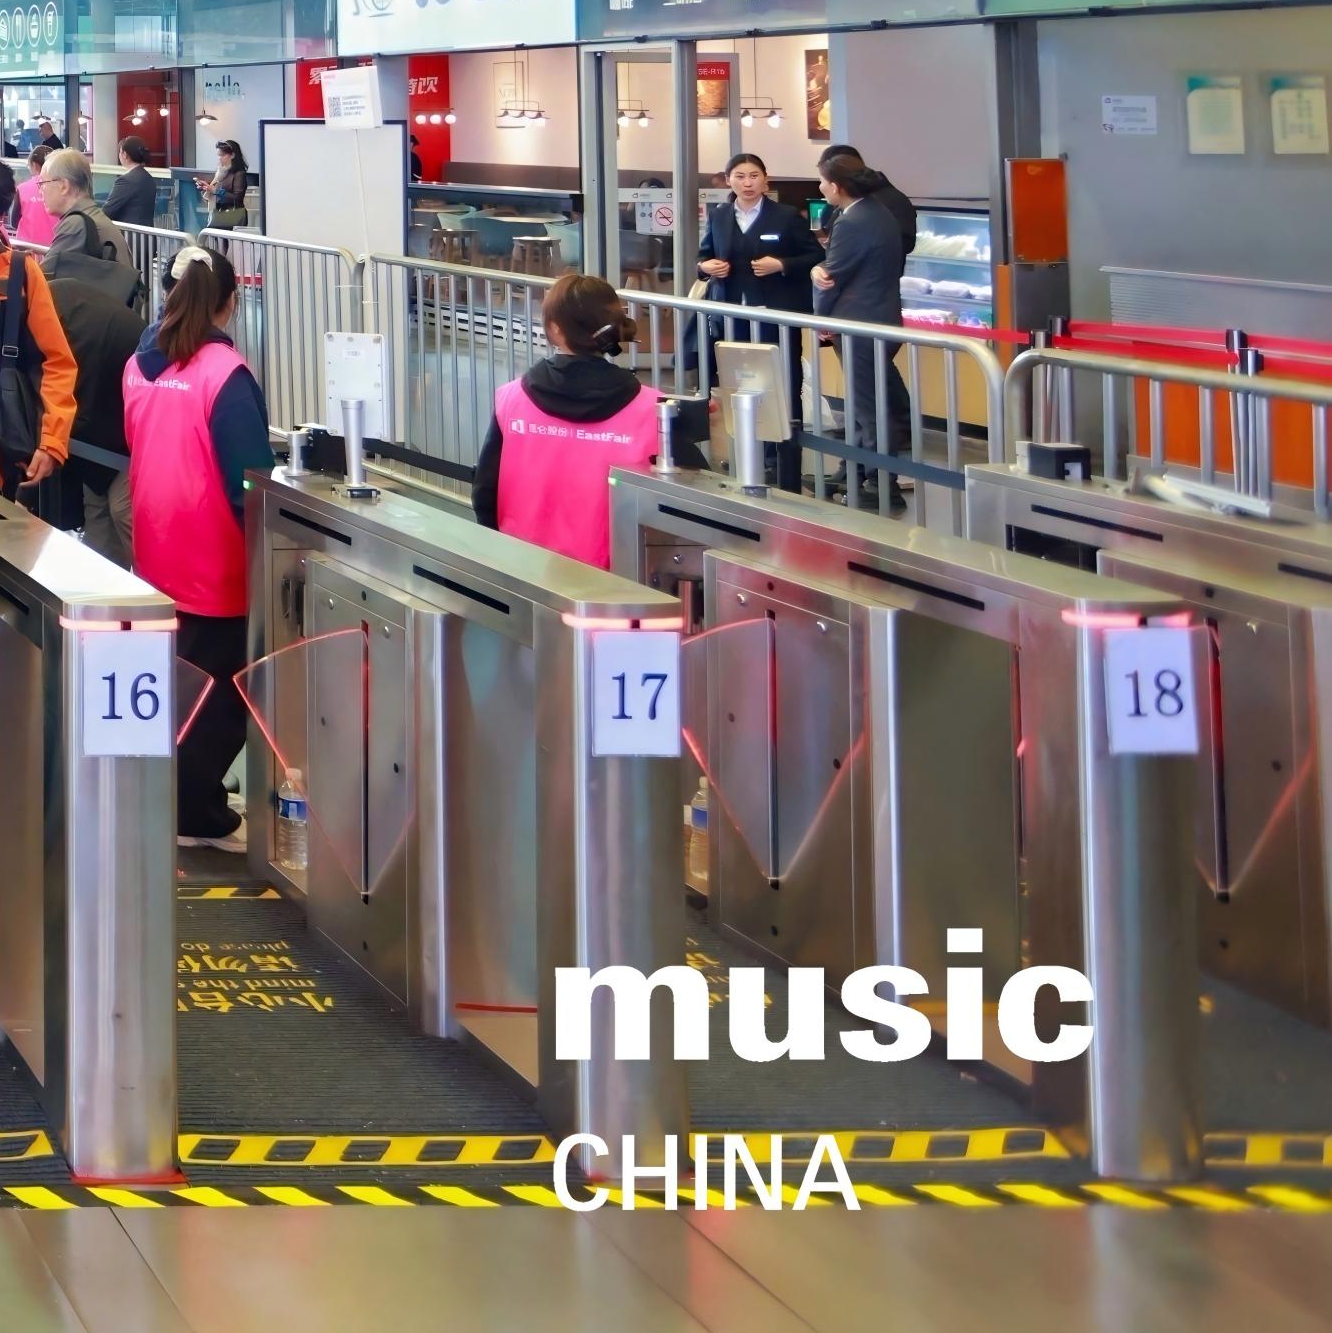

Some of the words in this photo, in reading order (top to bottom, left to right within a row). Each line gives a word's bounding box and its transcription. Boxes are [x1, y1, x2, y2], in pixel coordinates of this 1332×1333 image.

[576, 429, 631, 443] EastFair
[101, 671, 159, 720] 16
[610, 673, 669, 721] 17
[1126, 669, 1185, 719] 18
[181, 942, 210, 953] do
[193, 978, 240, 991] the
[178, 991, 335, 1013] 小心台
